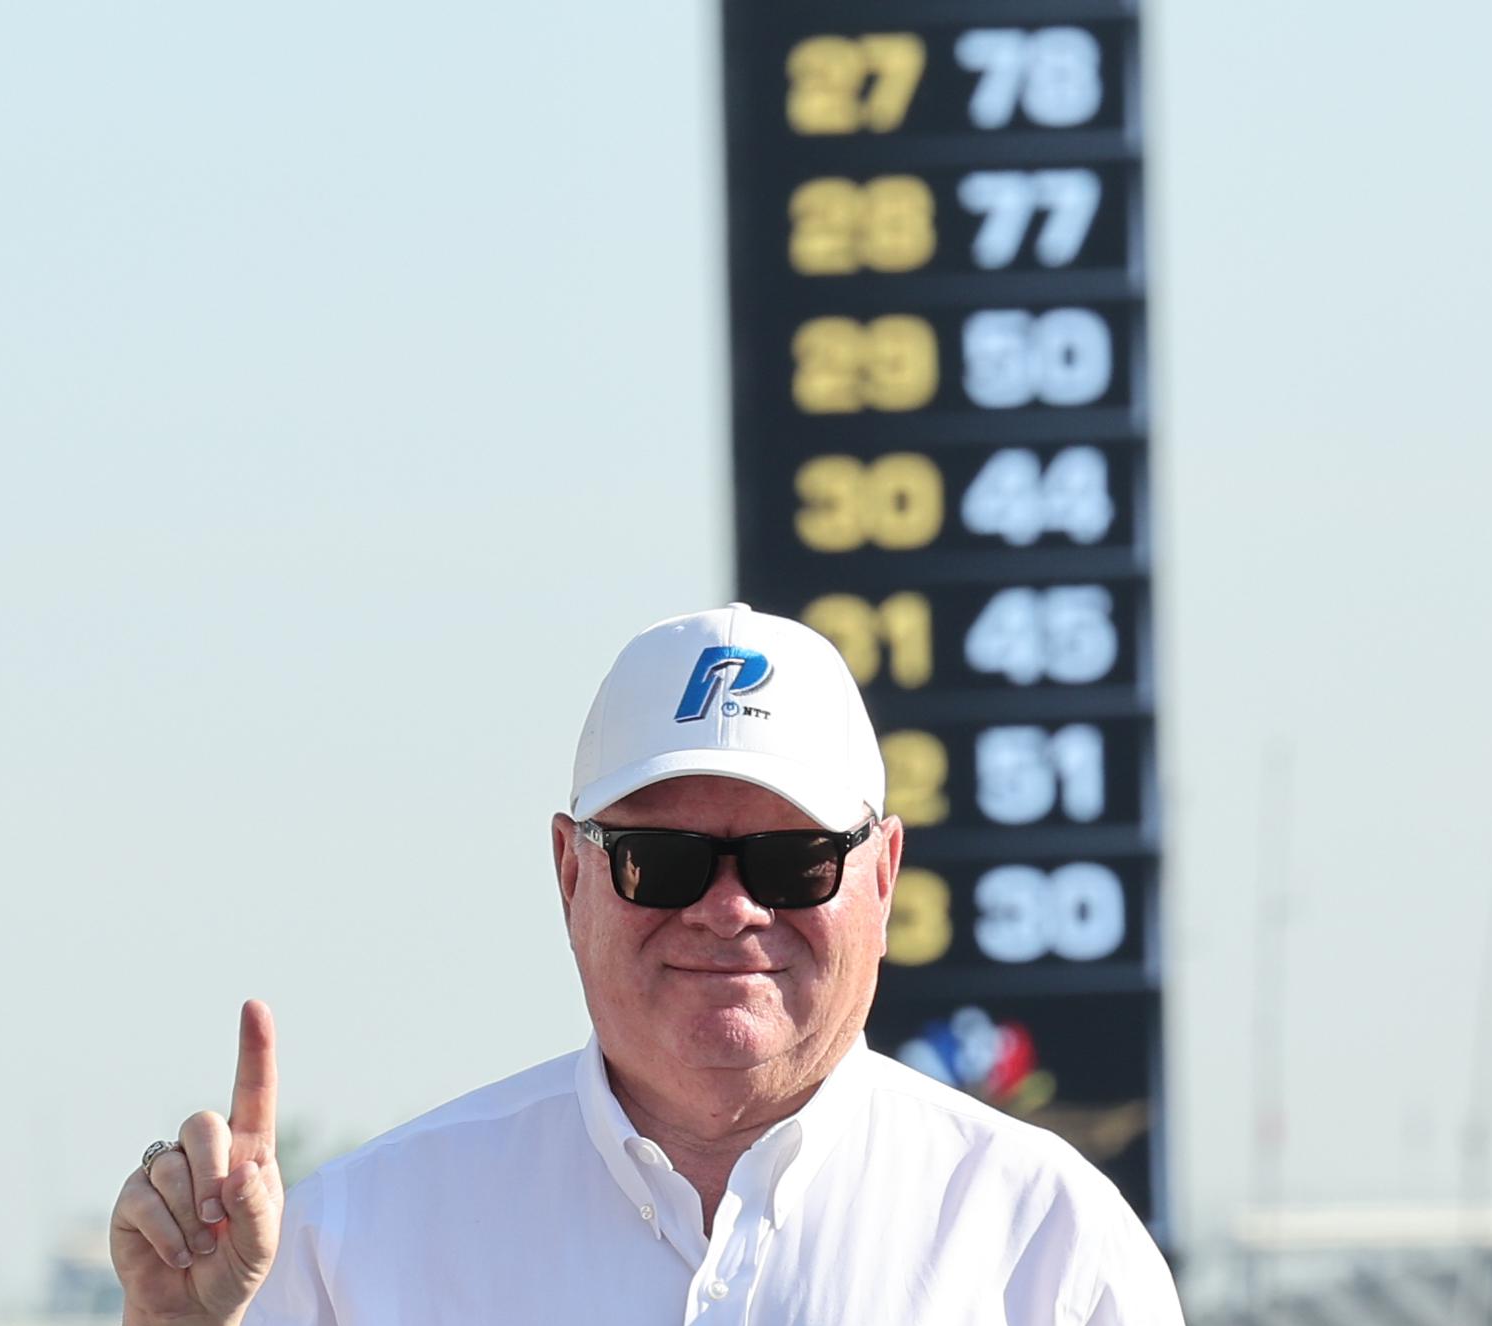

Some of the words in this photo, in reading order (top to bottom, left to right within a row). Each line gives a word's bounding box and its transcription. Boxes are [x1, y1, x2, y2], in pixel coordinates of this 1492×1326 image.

[786, 33, 925, 134] 27
[954, 26, 1102, 130] 78
[957, 168, 1102, 269] 77
[961, 308, 1113, 409] 50
[794, 452, 945, 553] 30
[961, 445, 1114, 546] 44
[964, 585, 1117, 686] 45
[743, 706, 771, 720] NTT
[882, 867, 952, 967] 3
